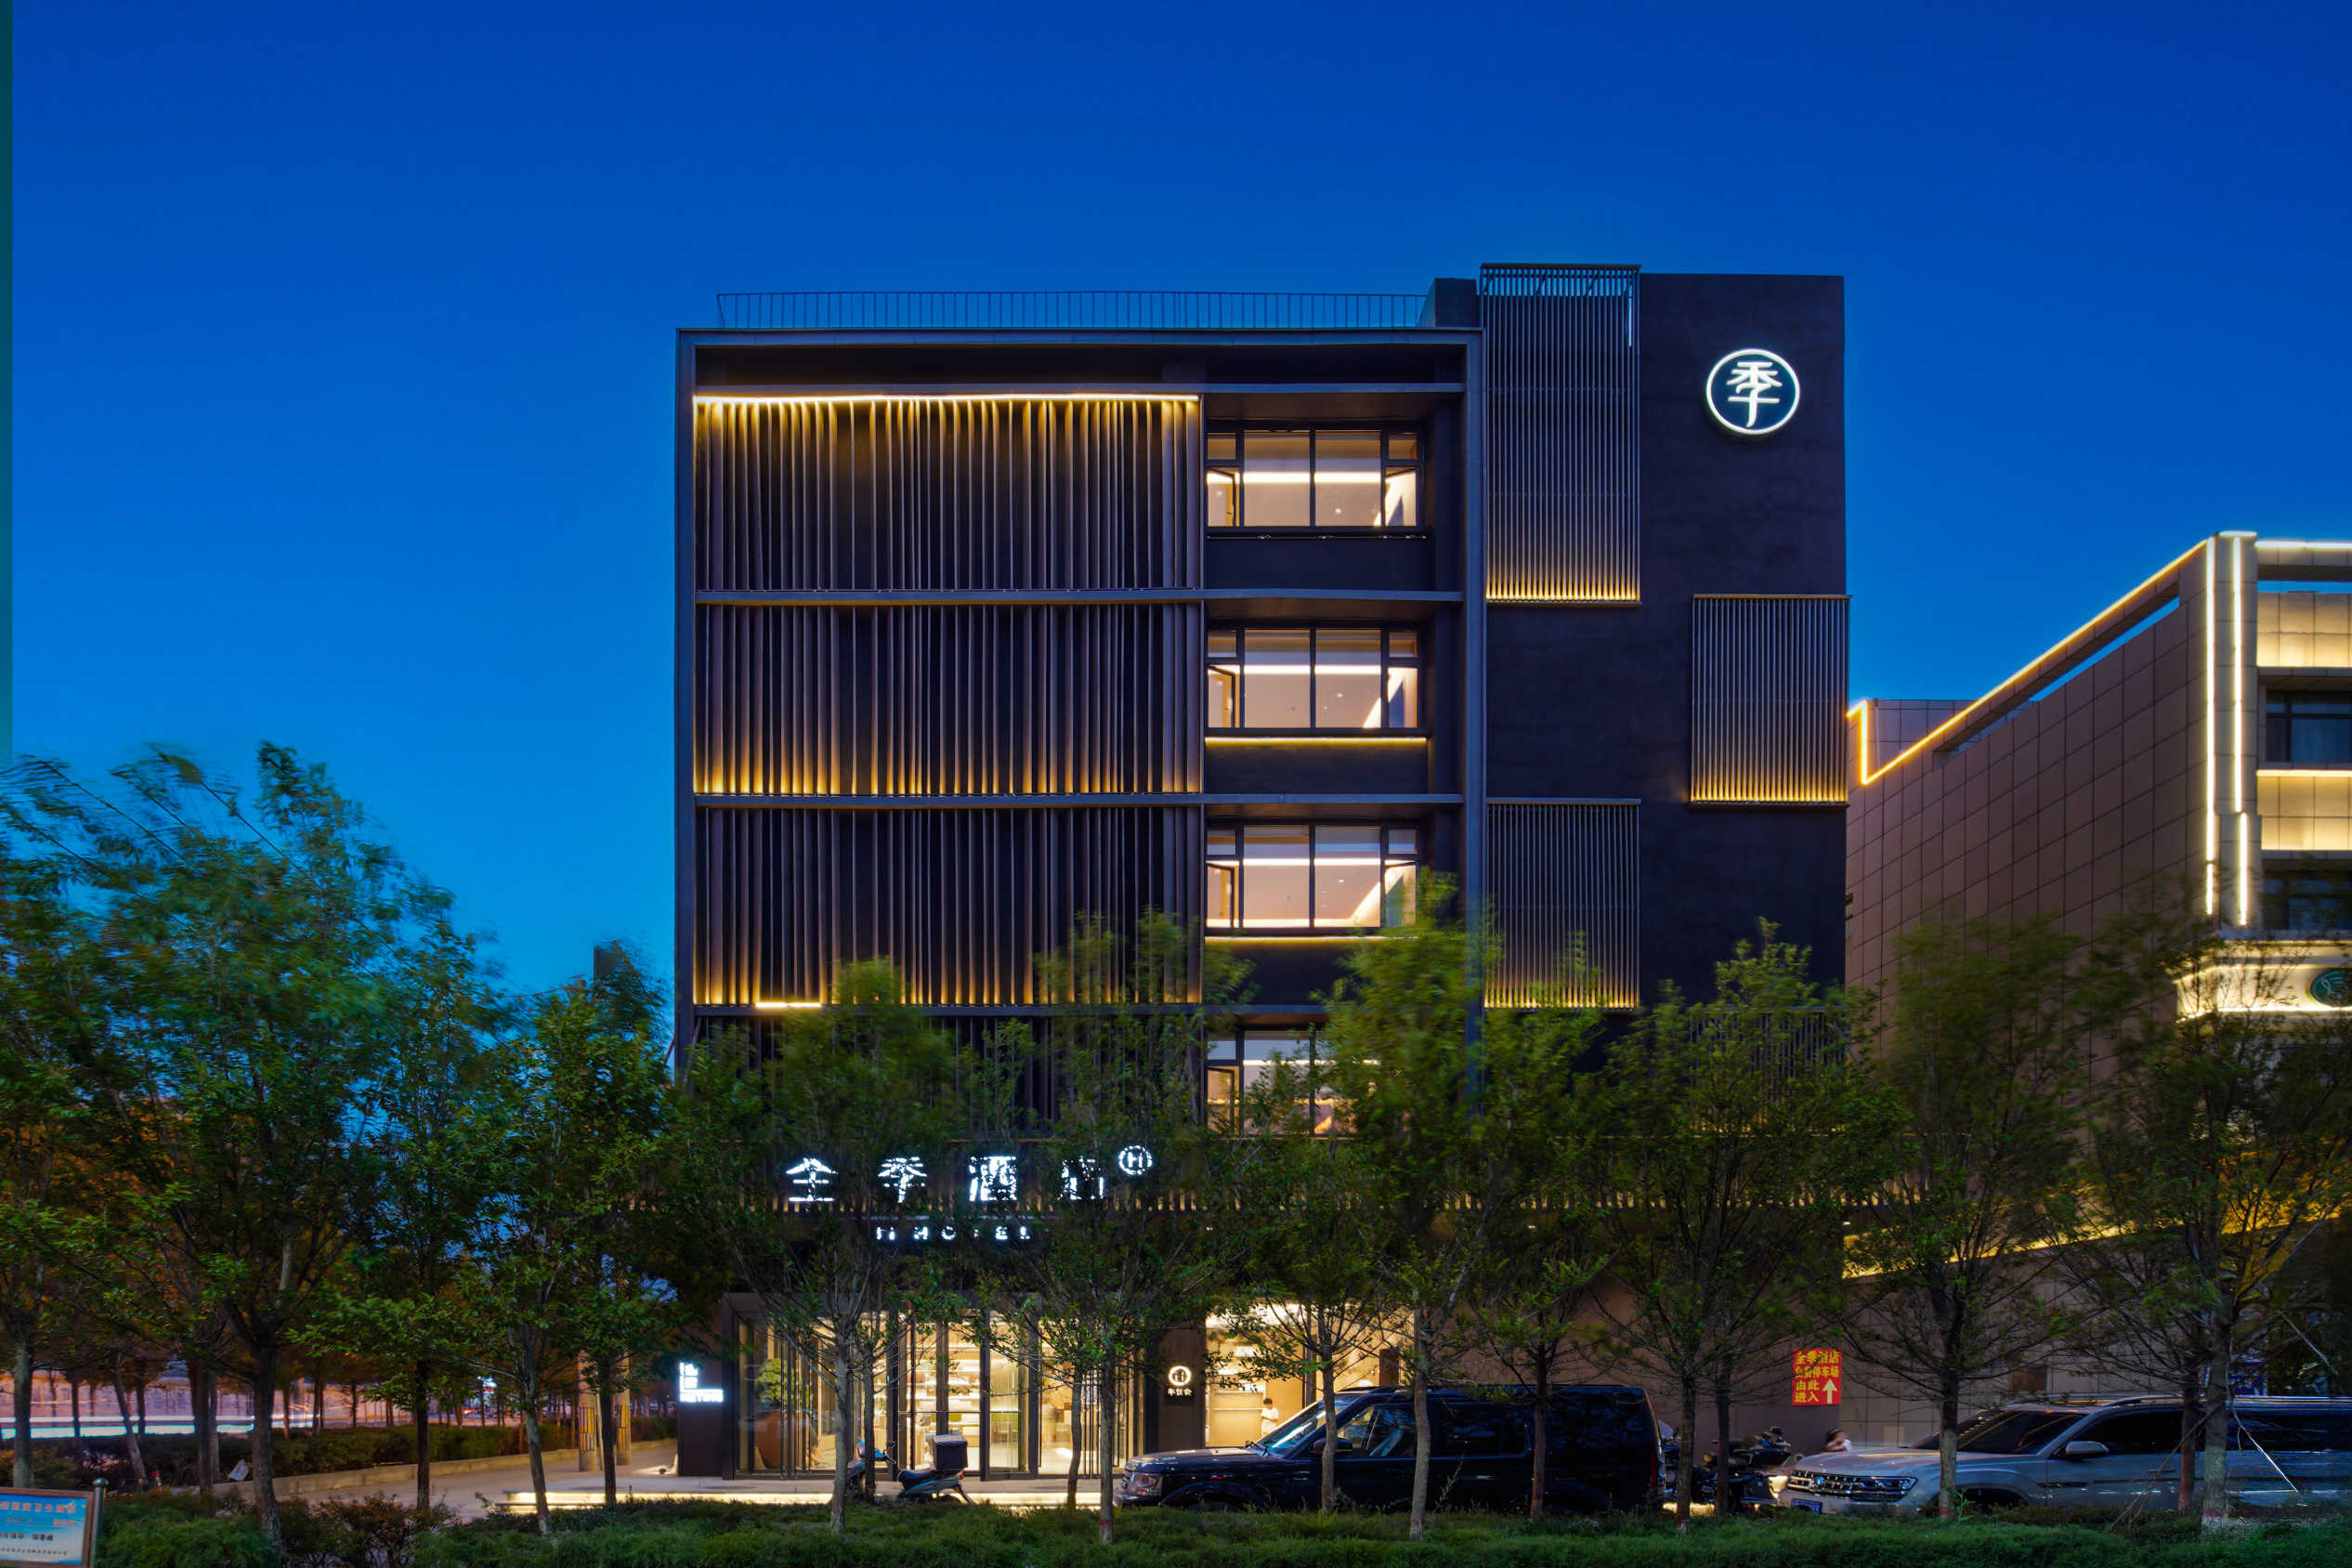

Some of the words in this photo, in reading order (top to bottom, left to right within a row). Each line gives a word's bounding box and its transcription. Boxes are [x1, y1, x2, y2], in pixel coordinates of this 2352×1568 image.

[1726, 360, 1783, 428] 季
[913, 1225, 1031, 1241] HOEL
[1796, 1351, 1840, 1365] 全季酒店
[1795, 1365, 1839, 1379] 免费停车场
[1796, 1379, 1820, 1392] 由此
[1795, 1391, 1820, 1403] 进入
